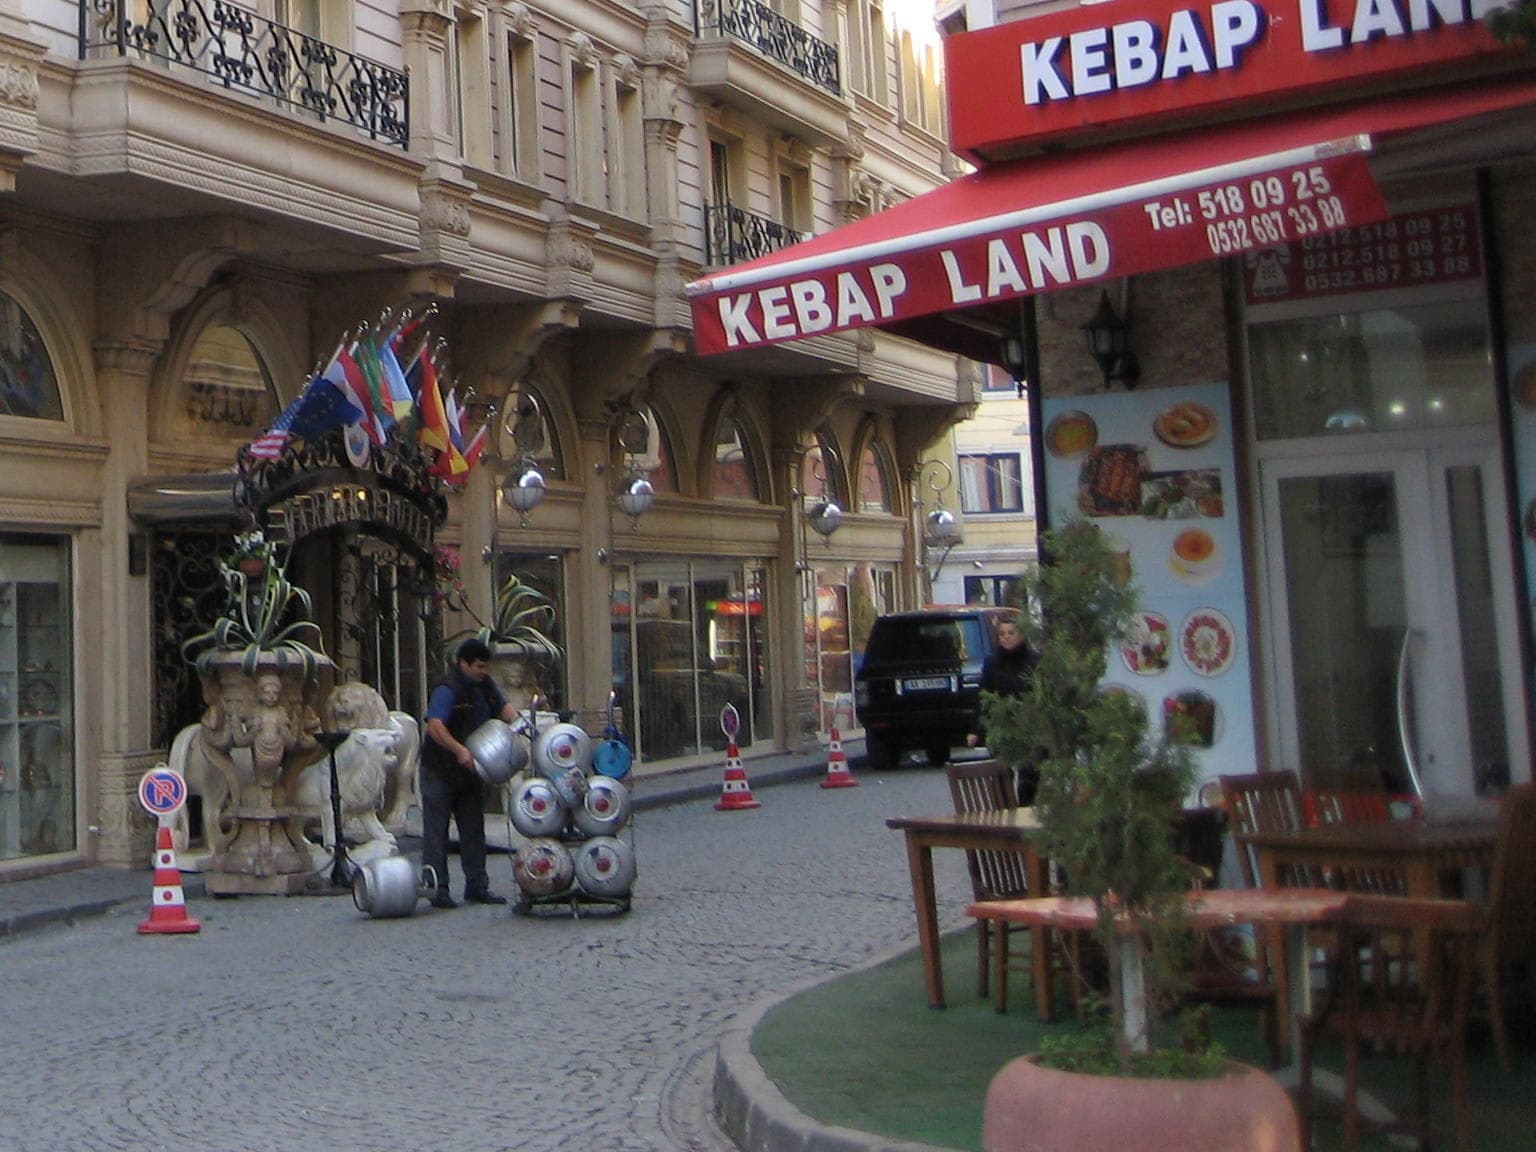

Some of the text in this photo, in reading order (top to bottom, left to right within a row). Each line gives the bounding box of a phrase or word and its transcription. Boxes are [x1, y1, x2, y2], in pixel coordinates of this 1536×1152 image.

[1143, 166, 1331, 230] Tel: 518 09 25
[1206, 196, 1346, 254] 0532 687 33 88
[718, 220, 1112, 346] KEBAP LAND
